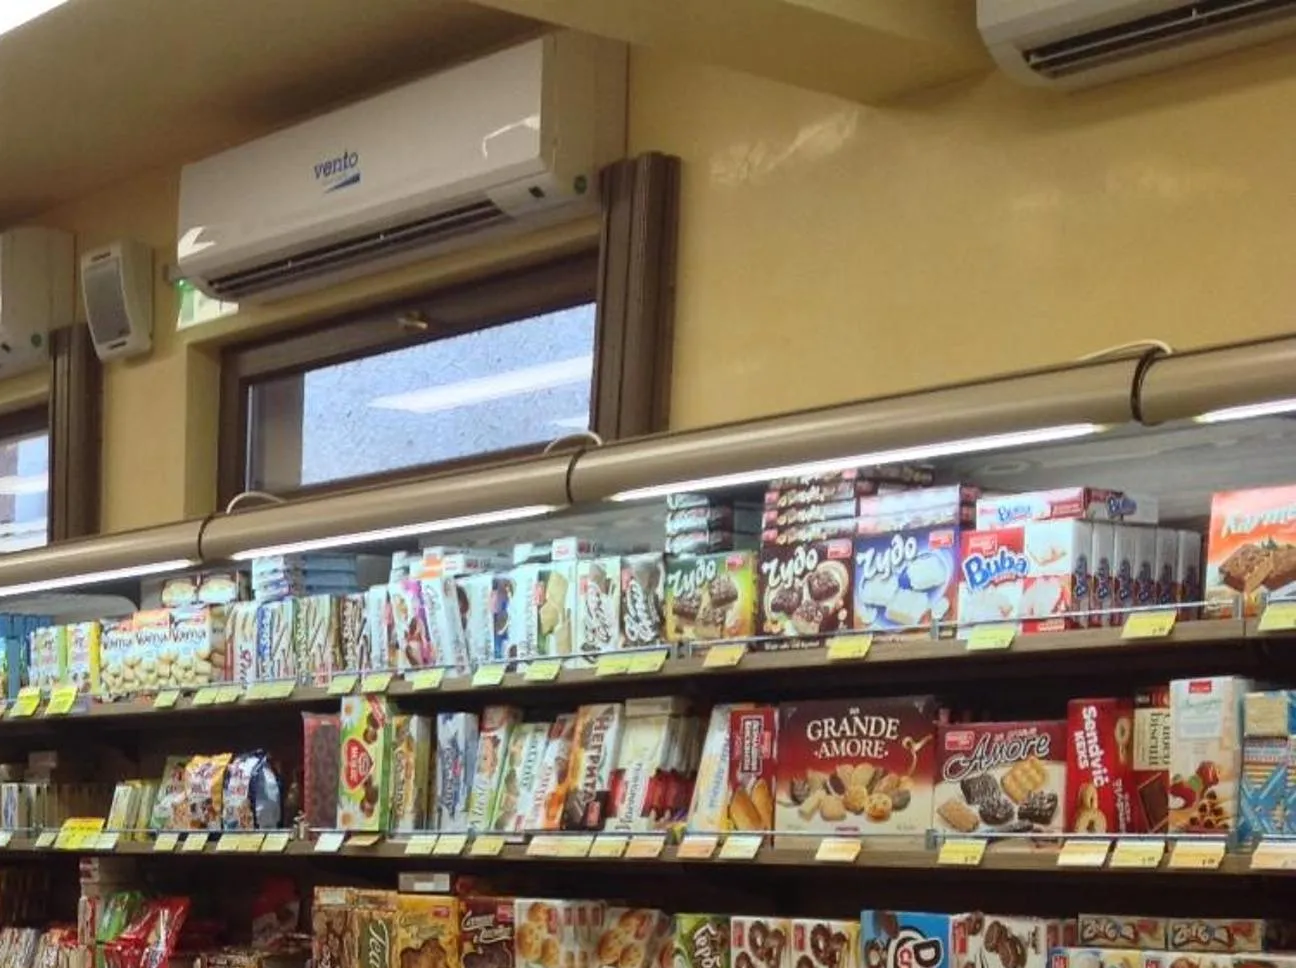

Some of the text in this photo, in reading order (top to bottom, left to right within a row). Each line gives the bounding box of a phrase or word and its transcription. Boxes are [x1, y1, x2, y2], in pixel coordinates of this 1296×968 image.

[313, 149, 360, 181] vento
[963, 550, 1028, 590] Buba
[806, 716, 900, 743] GRANDE
[817, 740, 887, 759] AMORE
[943, 733, 1050, 783] Amore
